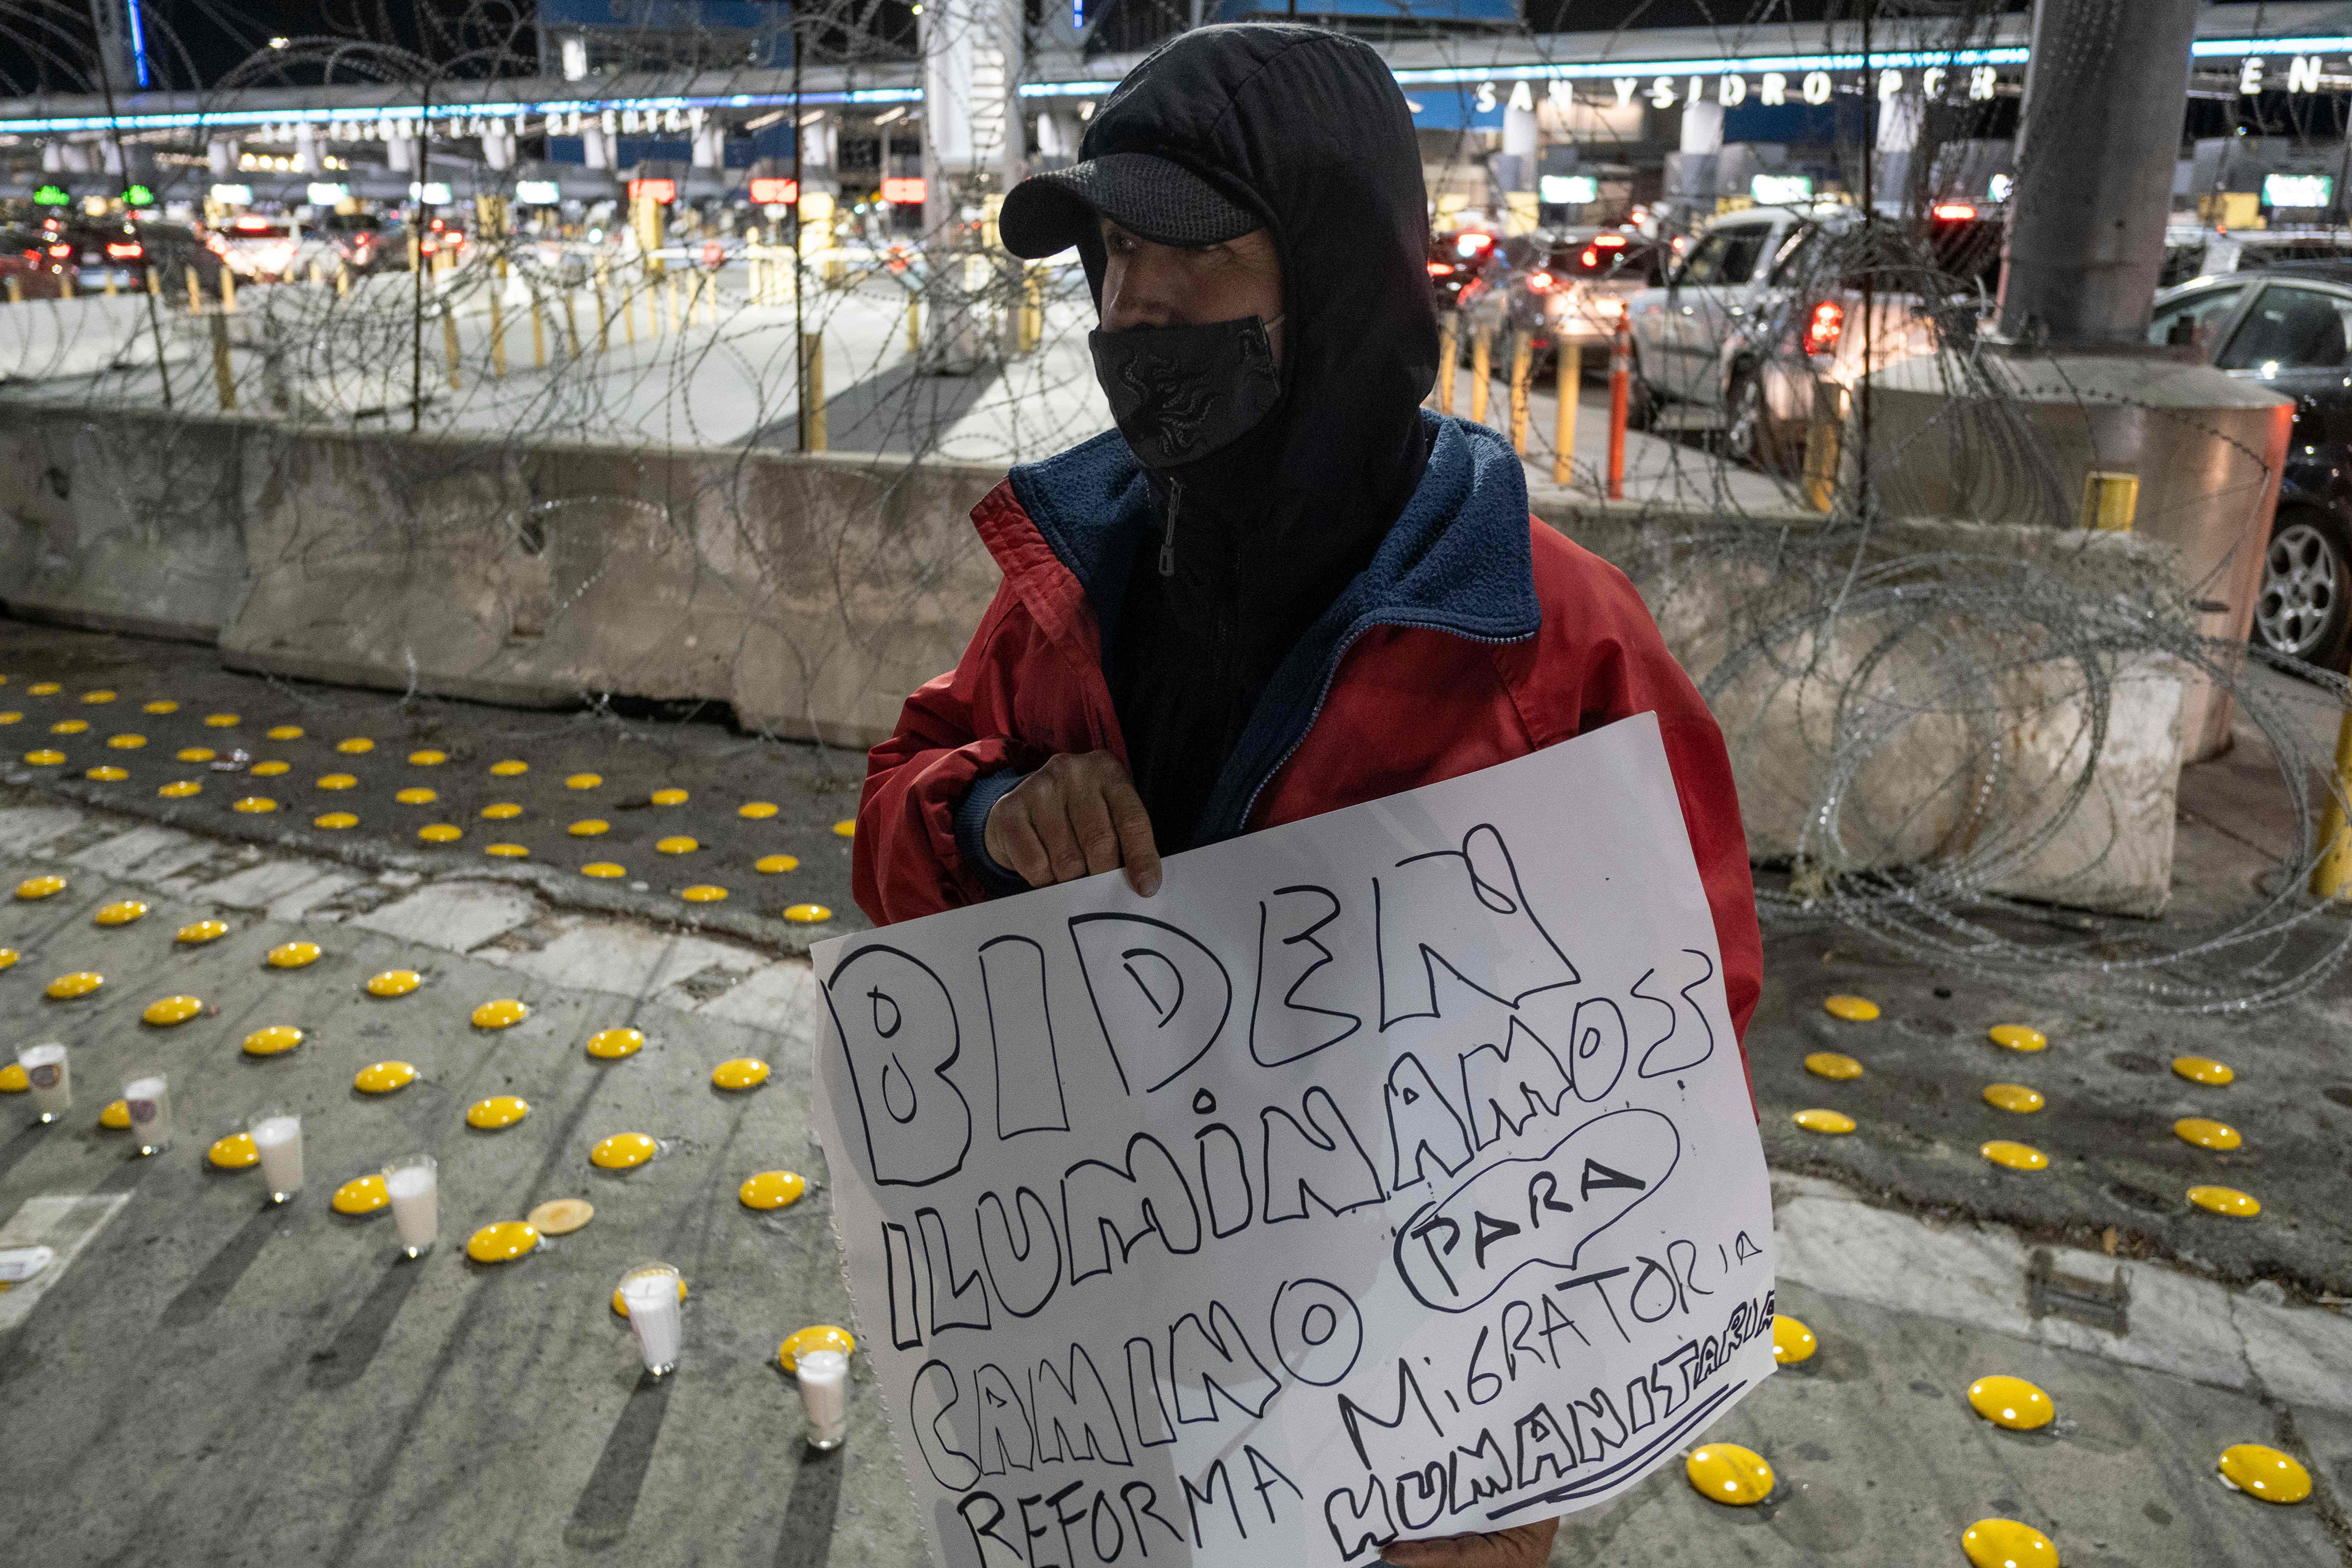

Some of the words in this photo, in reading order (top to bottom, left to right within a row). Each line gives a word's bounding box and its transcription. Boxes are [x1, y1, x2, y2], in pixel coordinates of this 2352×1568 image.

[1476, 79, 1573, 112] SAN
[1613, 72, 1831, 109] YSIDRO
[821, 824, 1581, 1186] BIDEN
[910, 1279, 1363, 1492] CAMINO
[1411, 1158, 1646, 1297] PARA
[957, 1445, 1303, 1568] REFORMA
